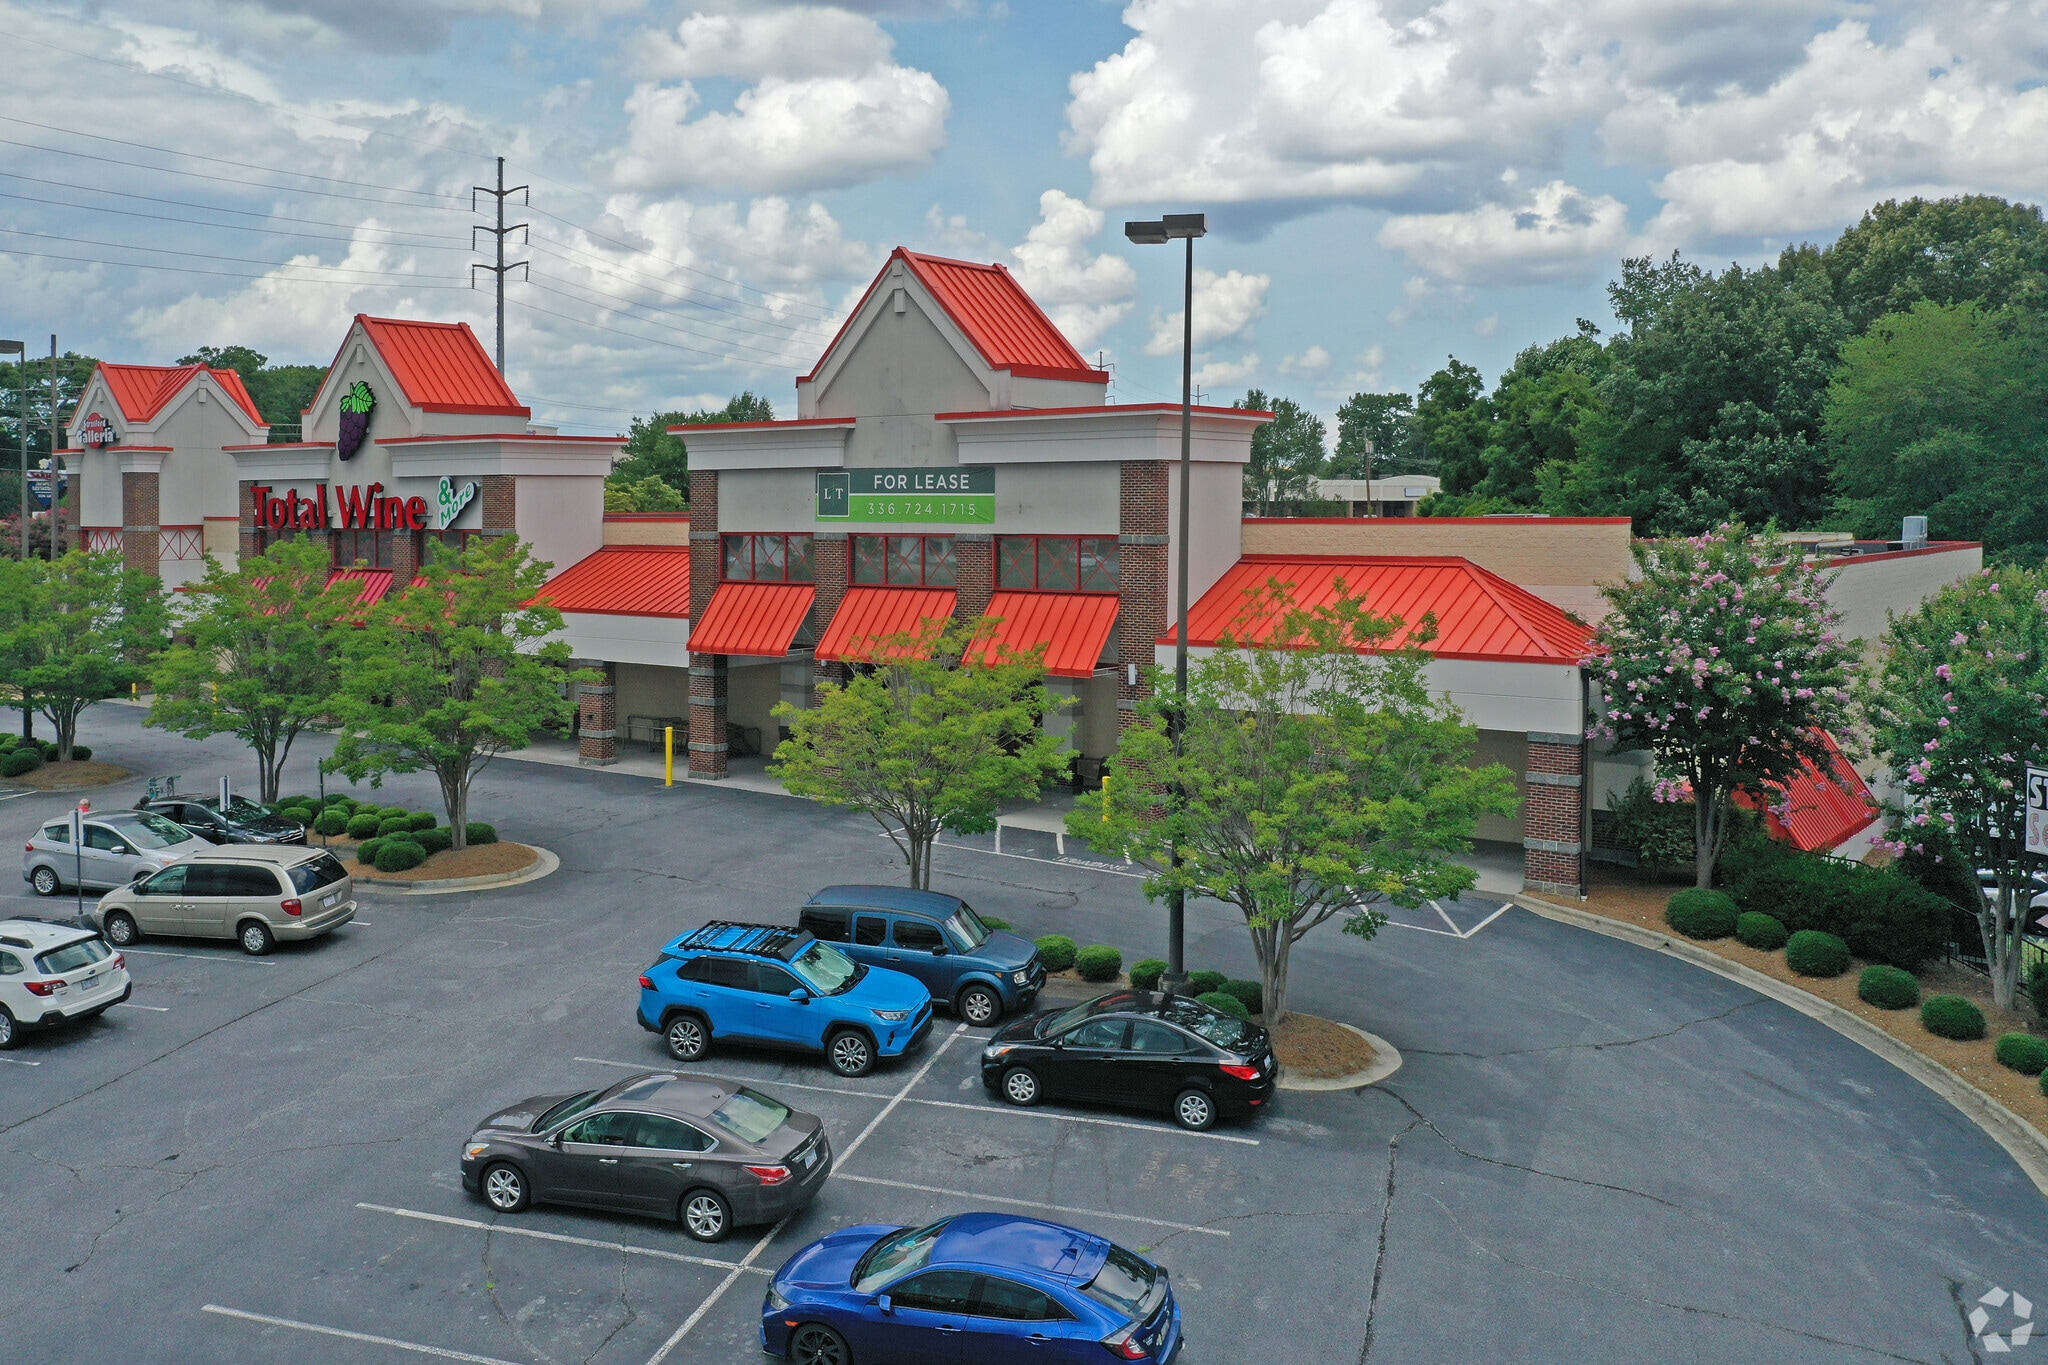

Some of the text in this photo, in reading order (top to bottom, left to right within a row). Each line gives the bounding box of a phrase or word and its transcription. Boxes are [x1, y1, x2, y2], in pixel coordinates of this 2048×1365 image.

[77, 427, 114, 443] Galleria
[874, 474, 970, 489] FOR LEASE
[251, 479, 450, 530] Total Wine &
[441, 486, 472, 527] More
[868, 503, 976, 516] 336.724.1715
